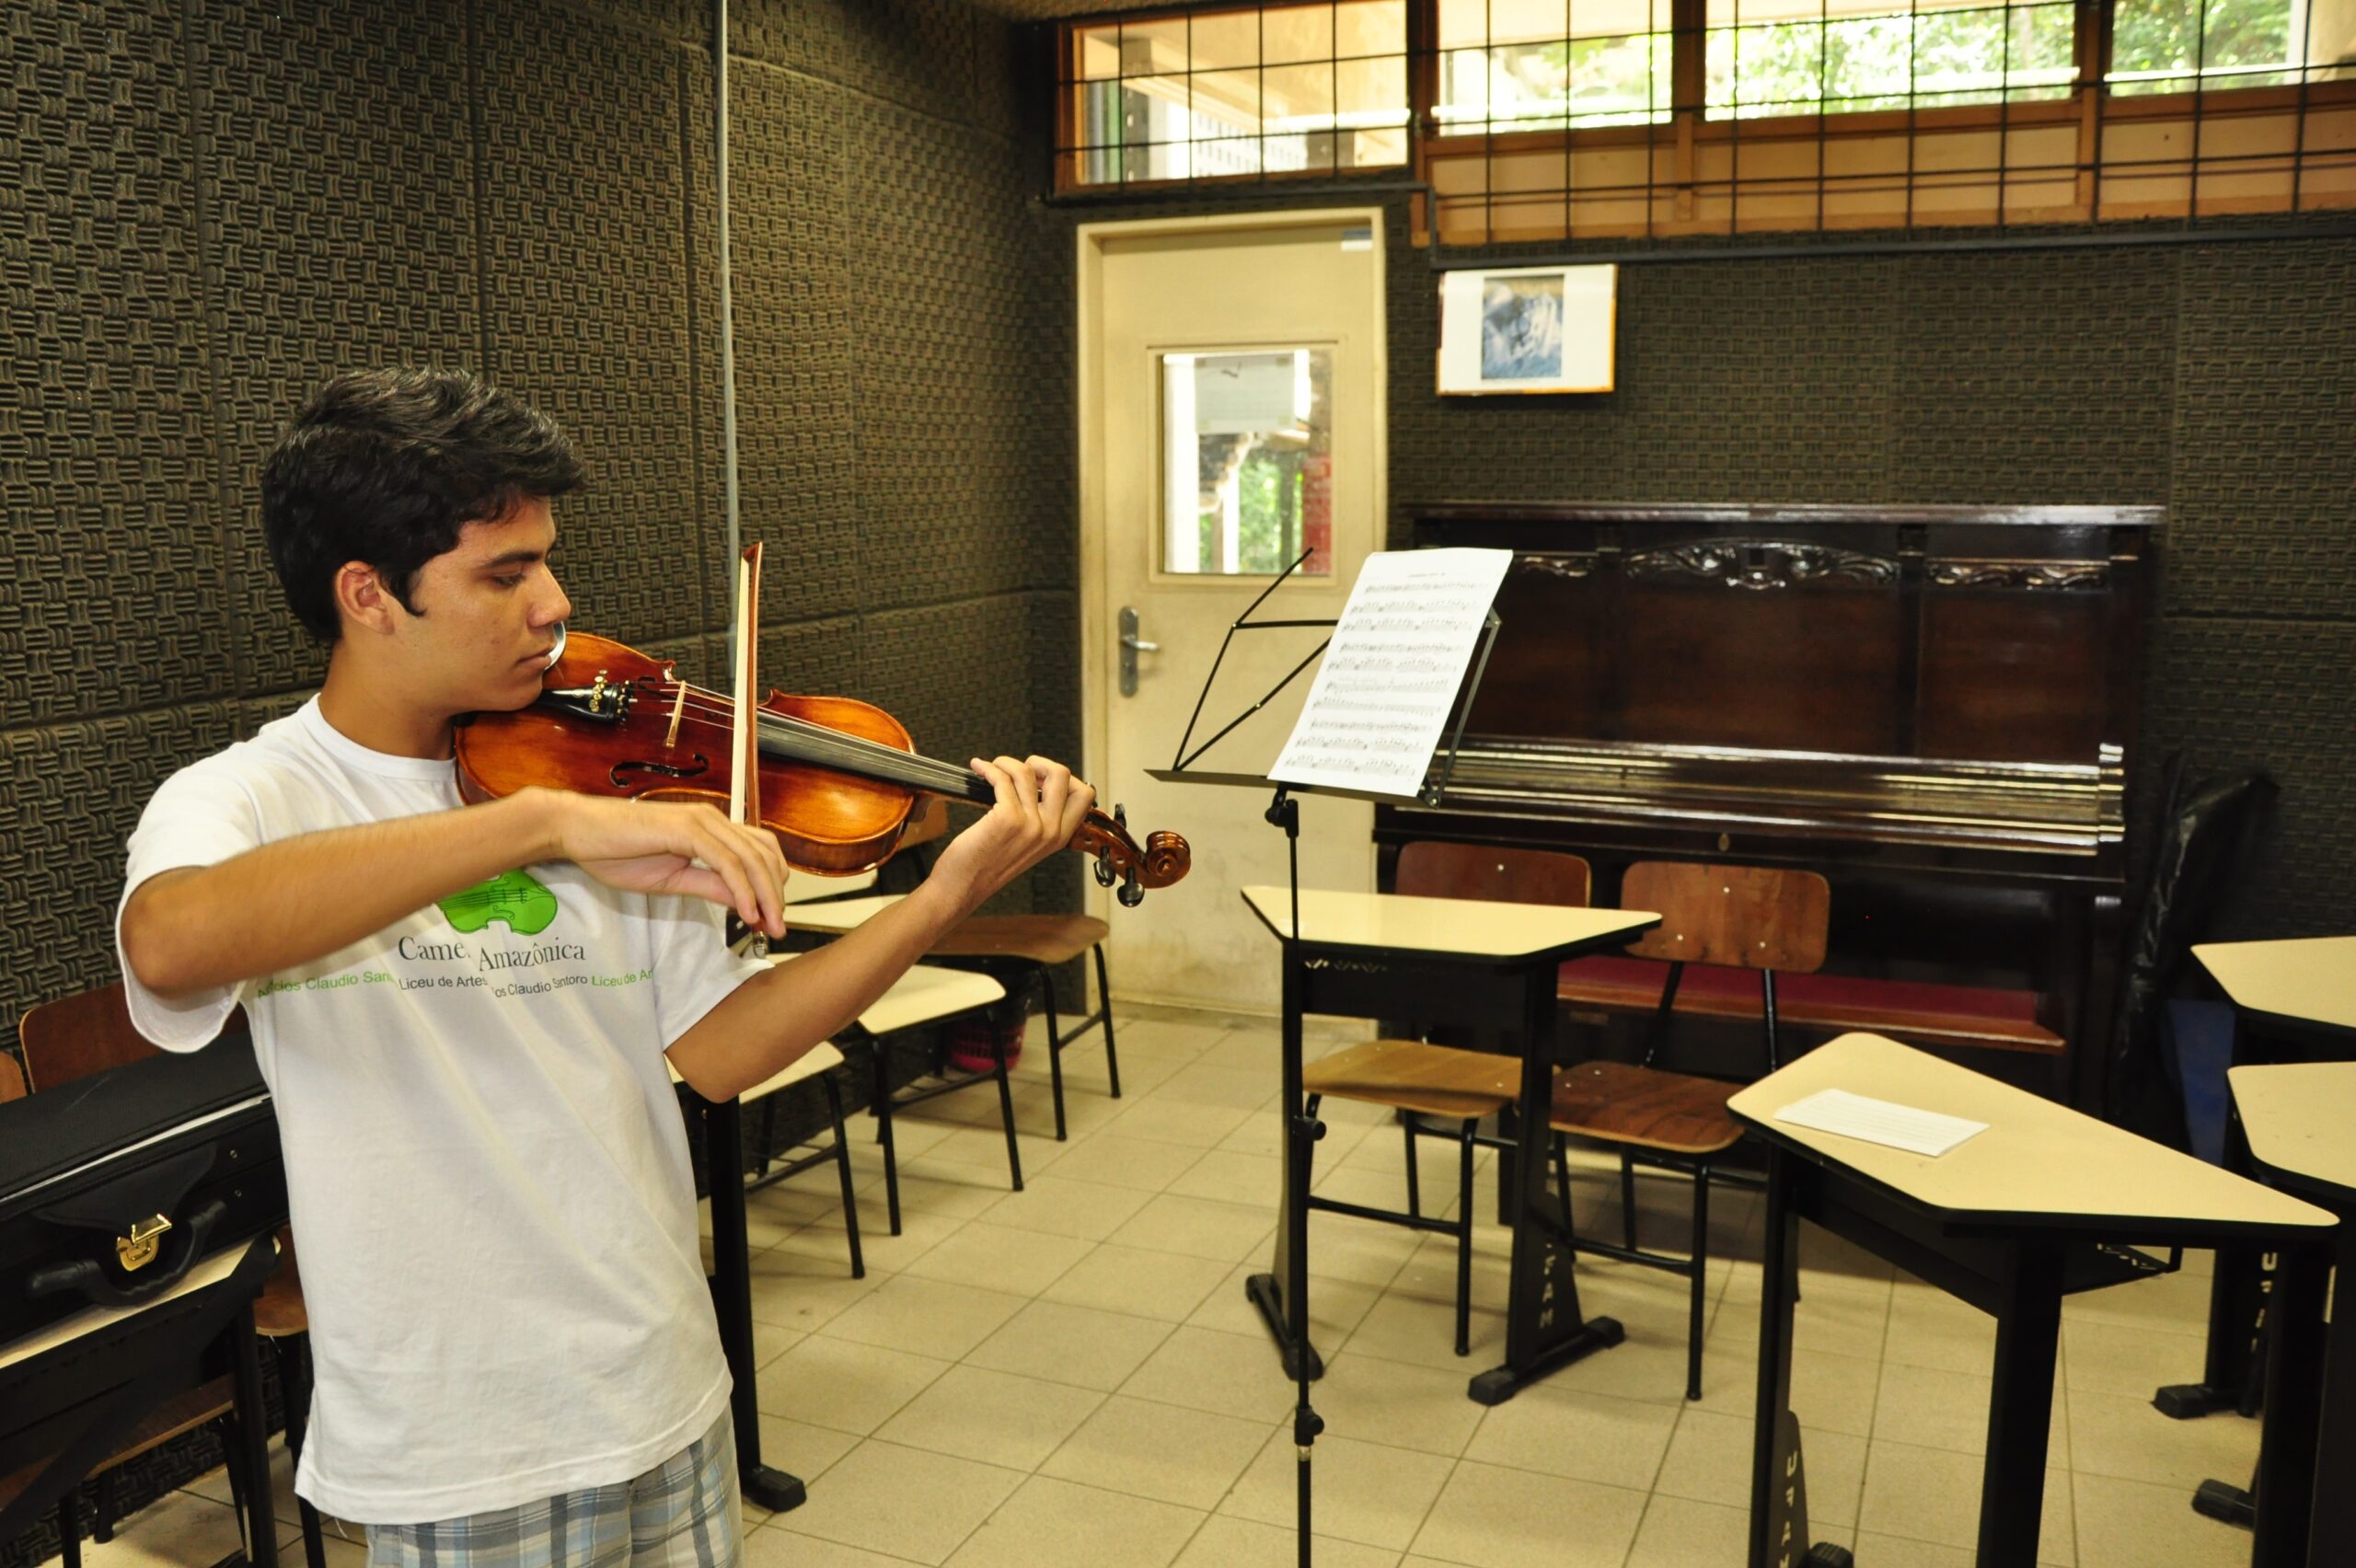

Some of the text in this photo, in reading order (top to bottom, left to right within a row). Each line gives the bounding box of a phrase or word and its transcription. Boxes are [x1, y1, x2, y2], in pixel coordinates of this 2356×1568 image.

[479, 937, 586, 972] Amazônica
[305, 974, 358, 991] Claudio
[398, 977, 434, 991] Liceu
[437, 975, 454, 987] de
[507, 980, 552, 996] Claudio
[592, 975, 623, 987] Liceu
[623, 973, 637, 985] de
